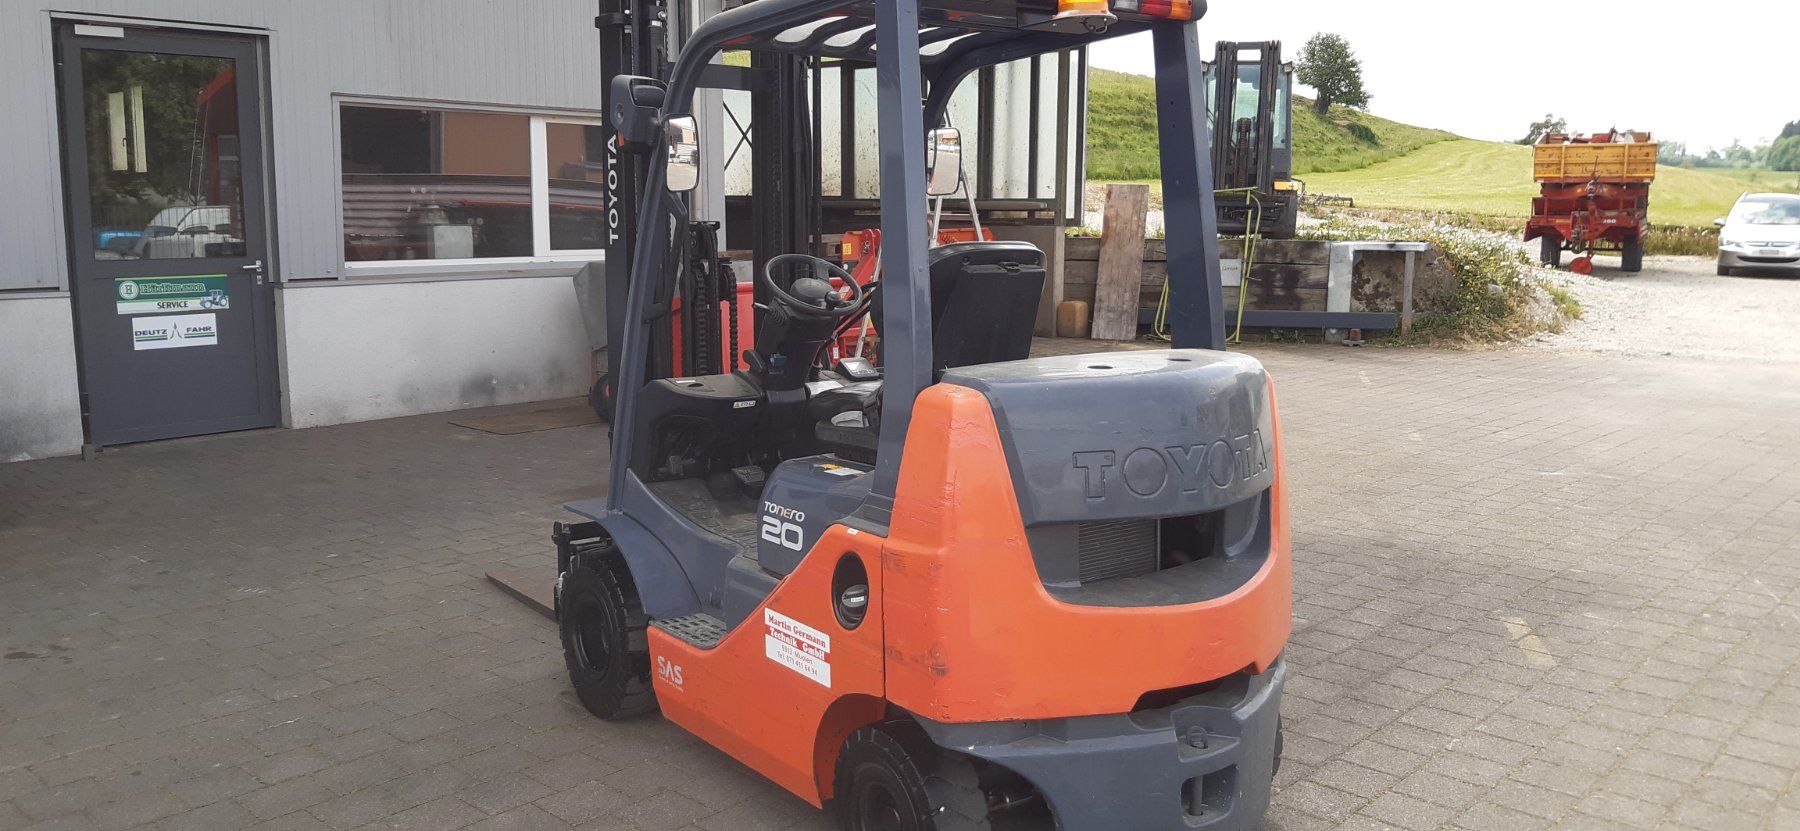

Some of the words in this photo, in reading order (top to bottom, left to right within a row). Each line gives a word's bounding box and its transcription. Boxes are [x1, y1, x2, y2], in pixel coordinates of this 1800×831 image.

[607, 134, 619, 245] TOYOTA
[157, 301, 188, 309] SERVICE
[1072, 428, 1268, 501] TOYOTA
[761, 515, 803, 551] 20
[768, 614, 791, 632] Martin
[793, 625, 826, 648] Germann
[770, 627, 798, 648] Technik
[802, 642, 825, 661] GmbH
[657, 656, 683, 685] SAS
